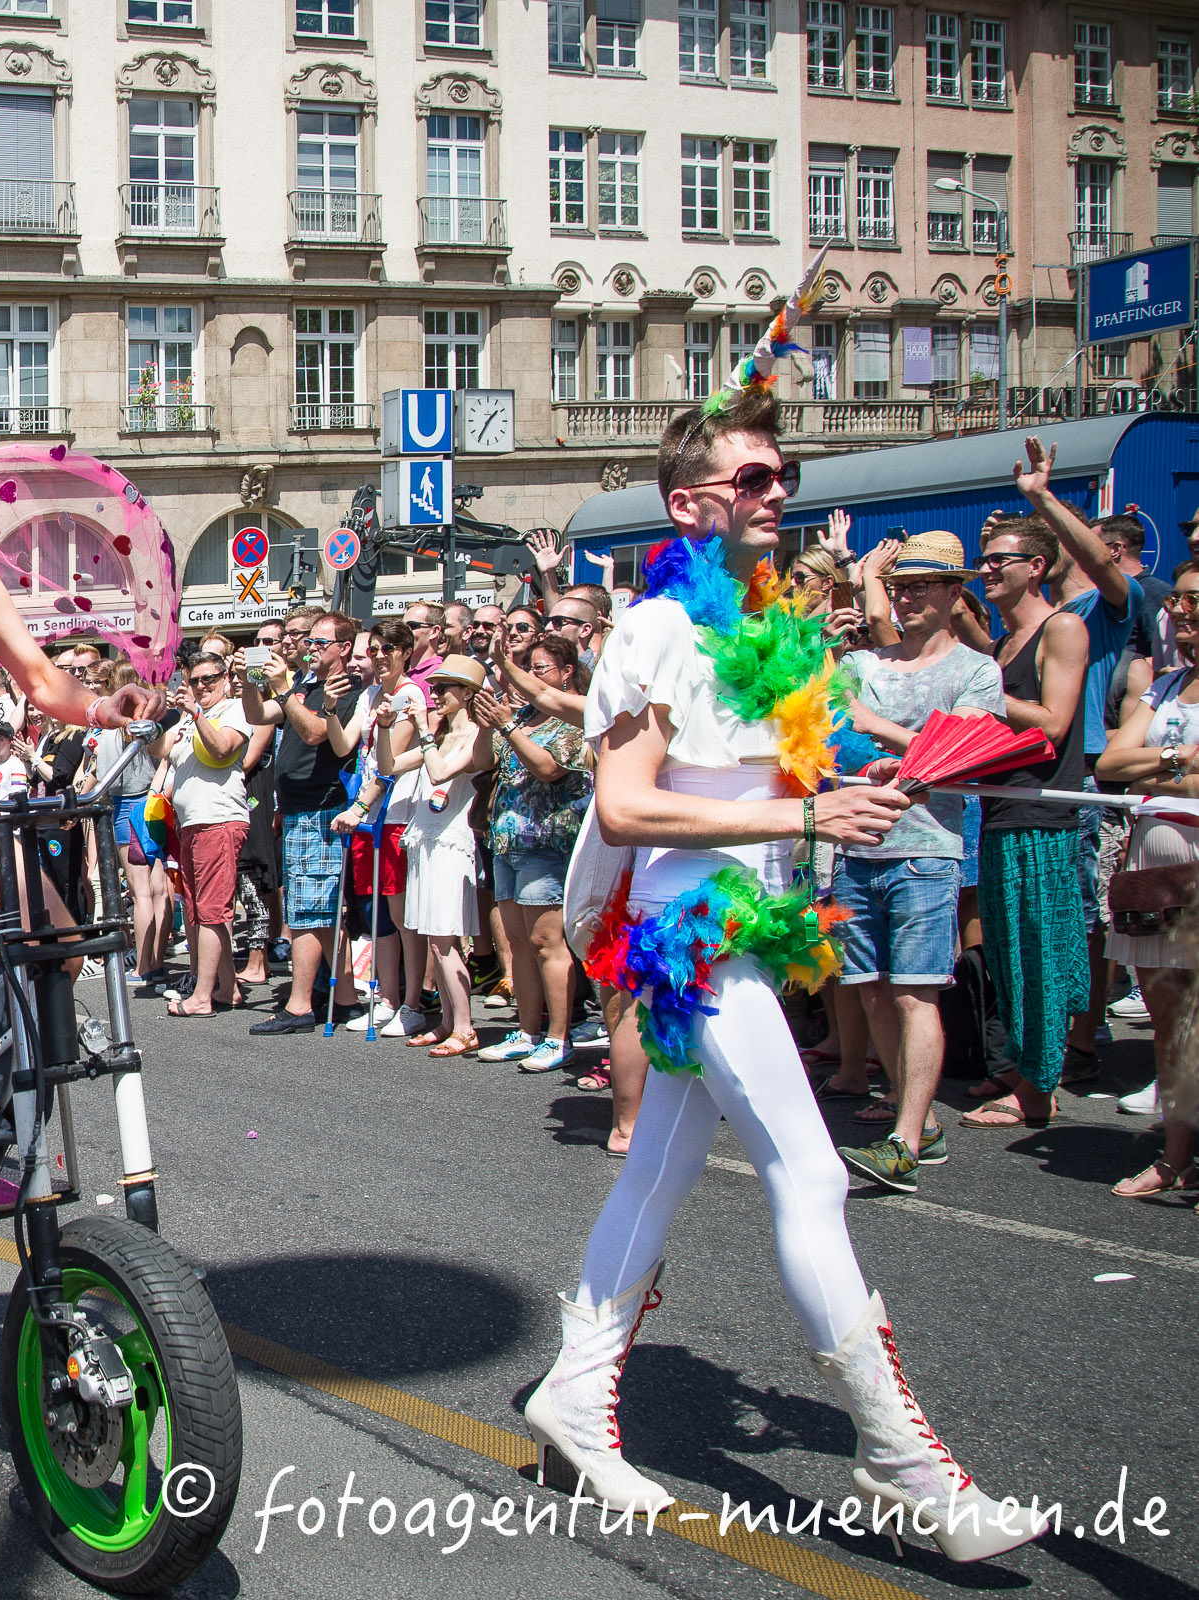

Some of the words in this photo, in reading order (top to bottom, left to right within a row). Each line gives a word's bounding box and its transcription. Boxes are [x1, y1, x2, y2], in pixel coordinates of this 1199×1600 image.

[1094, 300, 1183, 328] PFAFFINGER
[905, 343, 930, 356] HAAR
[408, 394, 445, 448] U
[372, 599, 394, 610] Cafe
[476, 594, 492, 604] Tor
[188, 609, 214, 621] Cafe
[218, 610, 235, 619] am
[113, 616, 132, 627] Tor
